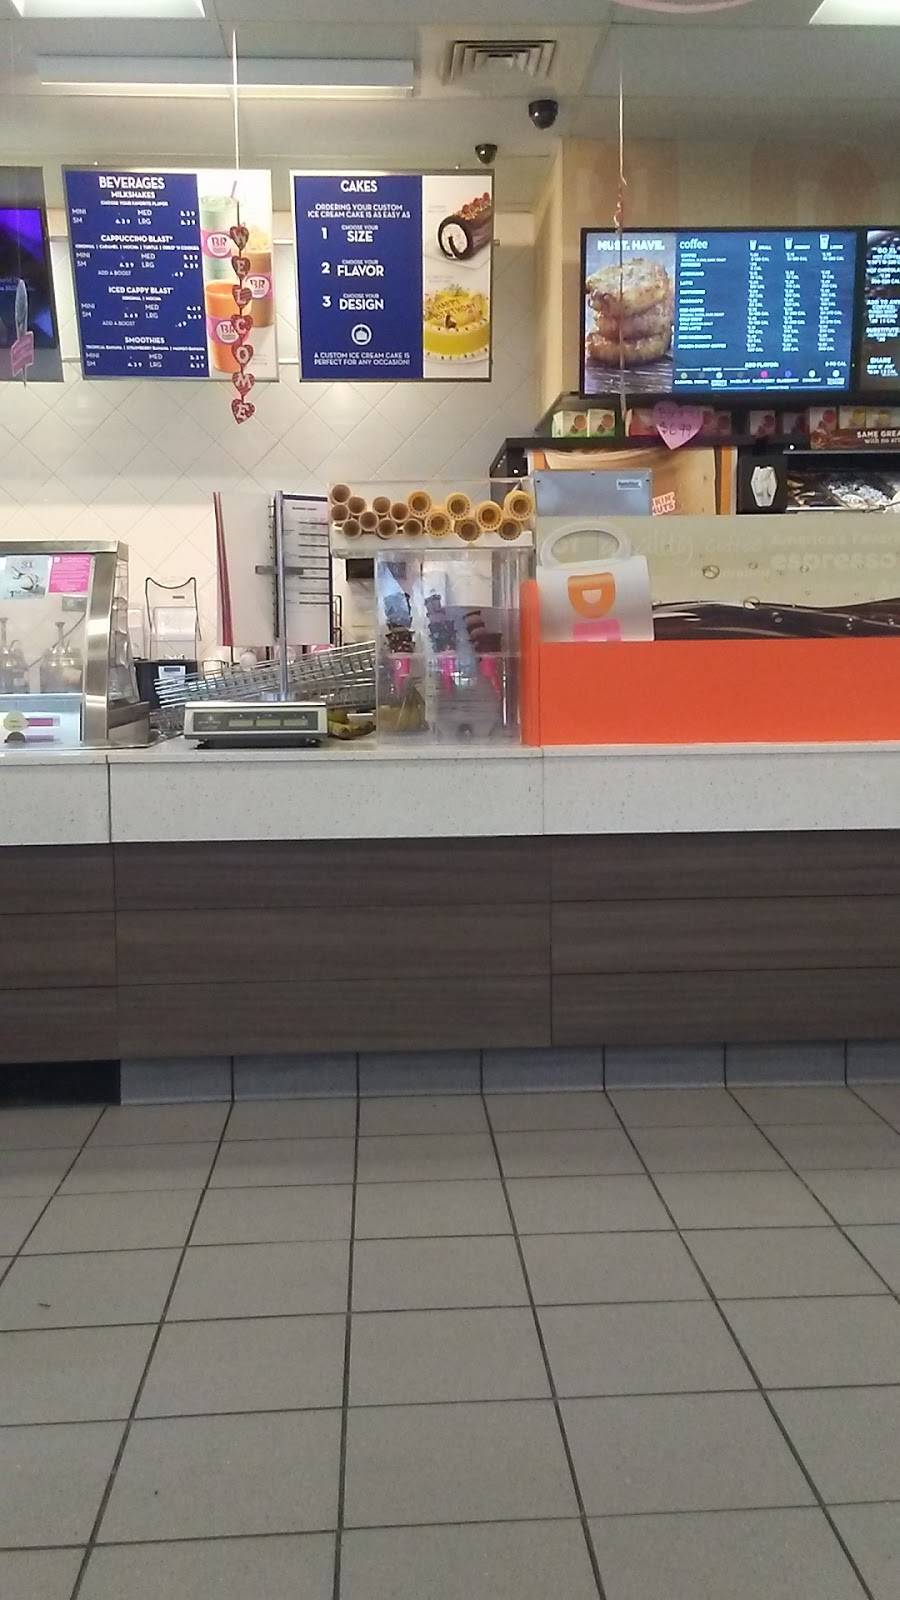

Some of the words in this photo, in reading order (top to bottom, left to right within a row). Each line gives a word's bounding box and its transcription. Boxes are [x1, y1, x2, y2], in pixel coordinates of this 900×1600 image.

[98, 176, 166, 190] BEVERAGES
[340, 179, 378, 192] CAKES
[111, 191, 156, 199] MILKSHAKES
[314, 203, 352, 211] ORDERING
[352, 203, 372, 211] YOUR
[373, 203, 403, 211] CUSTOM
[72, 208, 87, 216] MINI
[138, 209, 153, 217] MED
[138, 218, 152, 226] LRG
[321, 227, 328, 240] 1
[347, 230, 374, 242] SIZE
[101, 234, 148, 243] CAPPUCCINO
[679, 238, 709, 250] coffee
[141, 261, 155, 269] LRG
[321, 261, 331, 274] 2
[337, 264, 384, 277] FLAVOR
[108, 286, 124, 294] ICED
[126, 286, 149, 295] CAPPY
[322, 295, 332, 308] 3
[339, 298, 385, 311] DESIGN
[145, 311, 159, 319] LRG
[125, 336, 166, 345] SMOOTHIES
[149, 353, 163, 361] MED
[86, 360, 97, 368] SM
[149, 361, 163, 369] LRG
[314, 358, 342, 366] PERFECT
[343, 358, 358, 366] FOR
[358, 358, 373, 366] ANY
[857, 430, 879, 440] SAME
[770, 552, 897, 573] espresso
